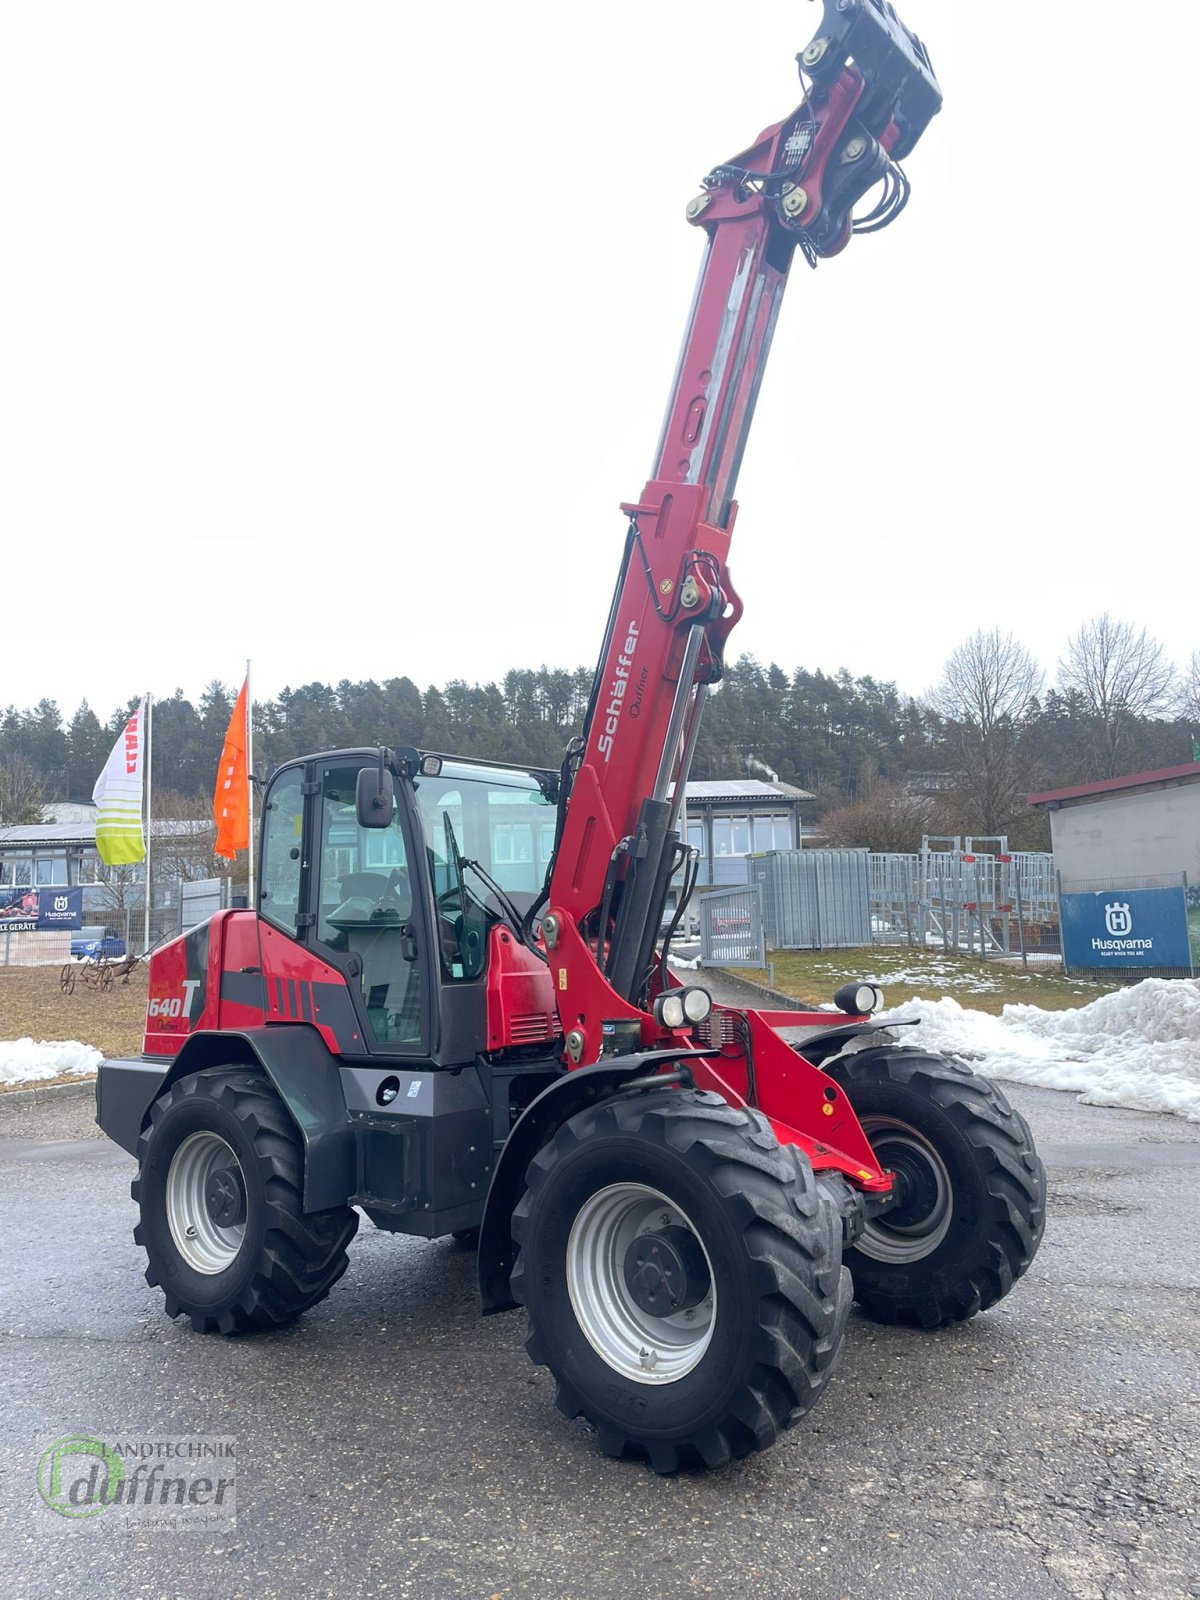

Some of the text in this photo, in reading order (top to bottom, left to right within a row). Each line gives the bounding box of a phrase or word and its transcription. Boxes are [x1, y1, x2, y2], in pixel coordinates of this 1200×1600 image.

[598, 620, 639, 763] Schäffer
[628, 667, 649, 719] Duffner
[9, 921, 37, 931] GERÄTE
[1091, 937, 1153, 951] Husqvarna
